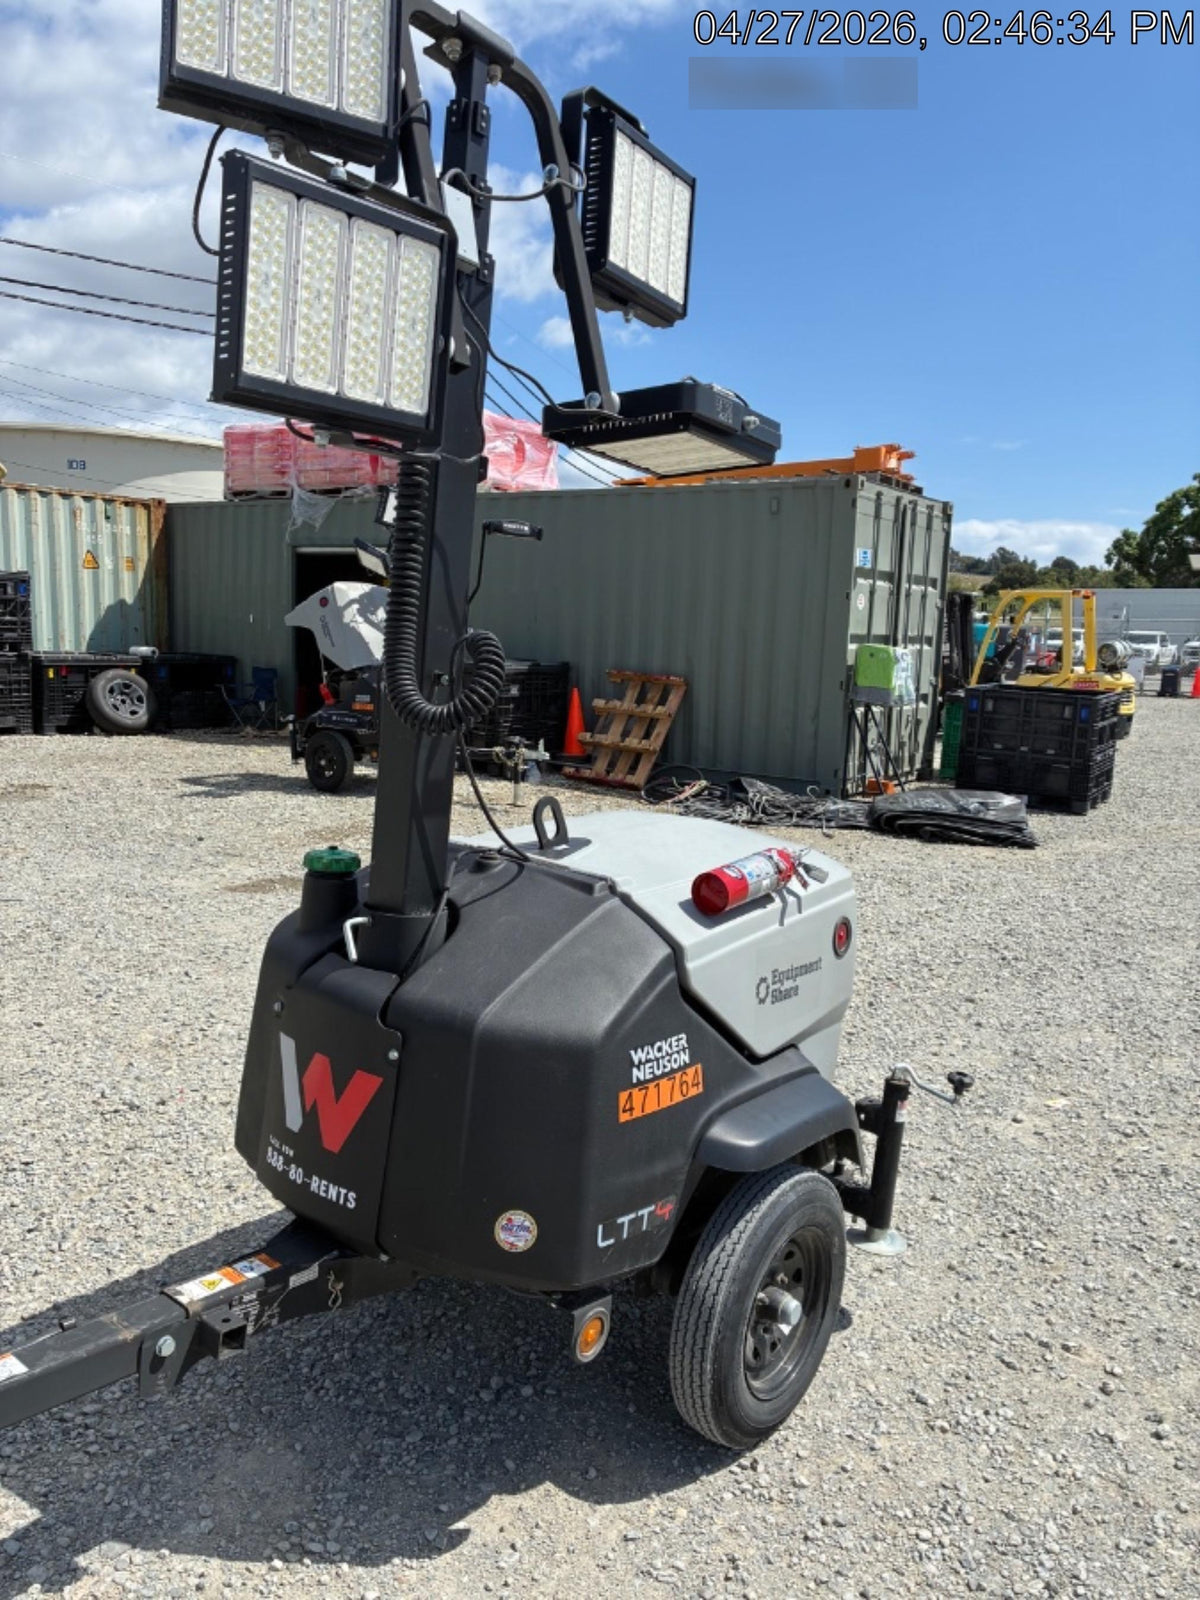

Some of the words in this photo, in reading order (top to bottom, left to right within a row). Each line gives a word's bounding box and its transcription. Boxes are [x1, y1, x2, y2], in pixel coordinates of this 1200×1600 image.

[771, 956, 822, 986] Equipment
[771, 984, 799, 1005] Share
[629, 1032, 688, 1066] WACKER
[632, 1048, 690, 1083] NEUSON
[621, 1066, 701, 1117] 471764
[266, 1146, 357, 1209] 888-80-RENTS
